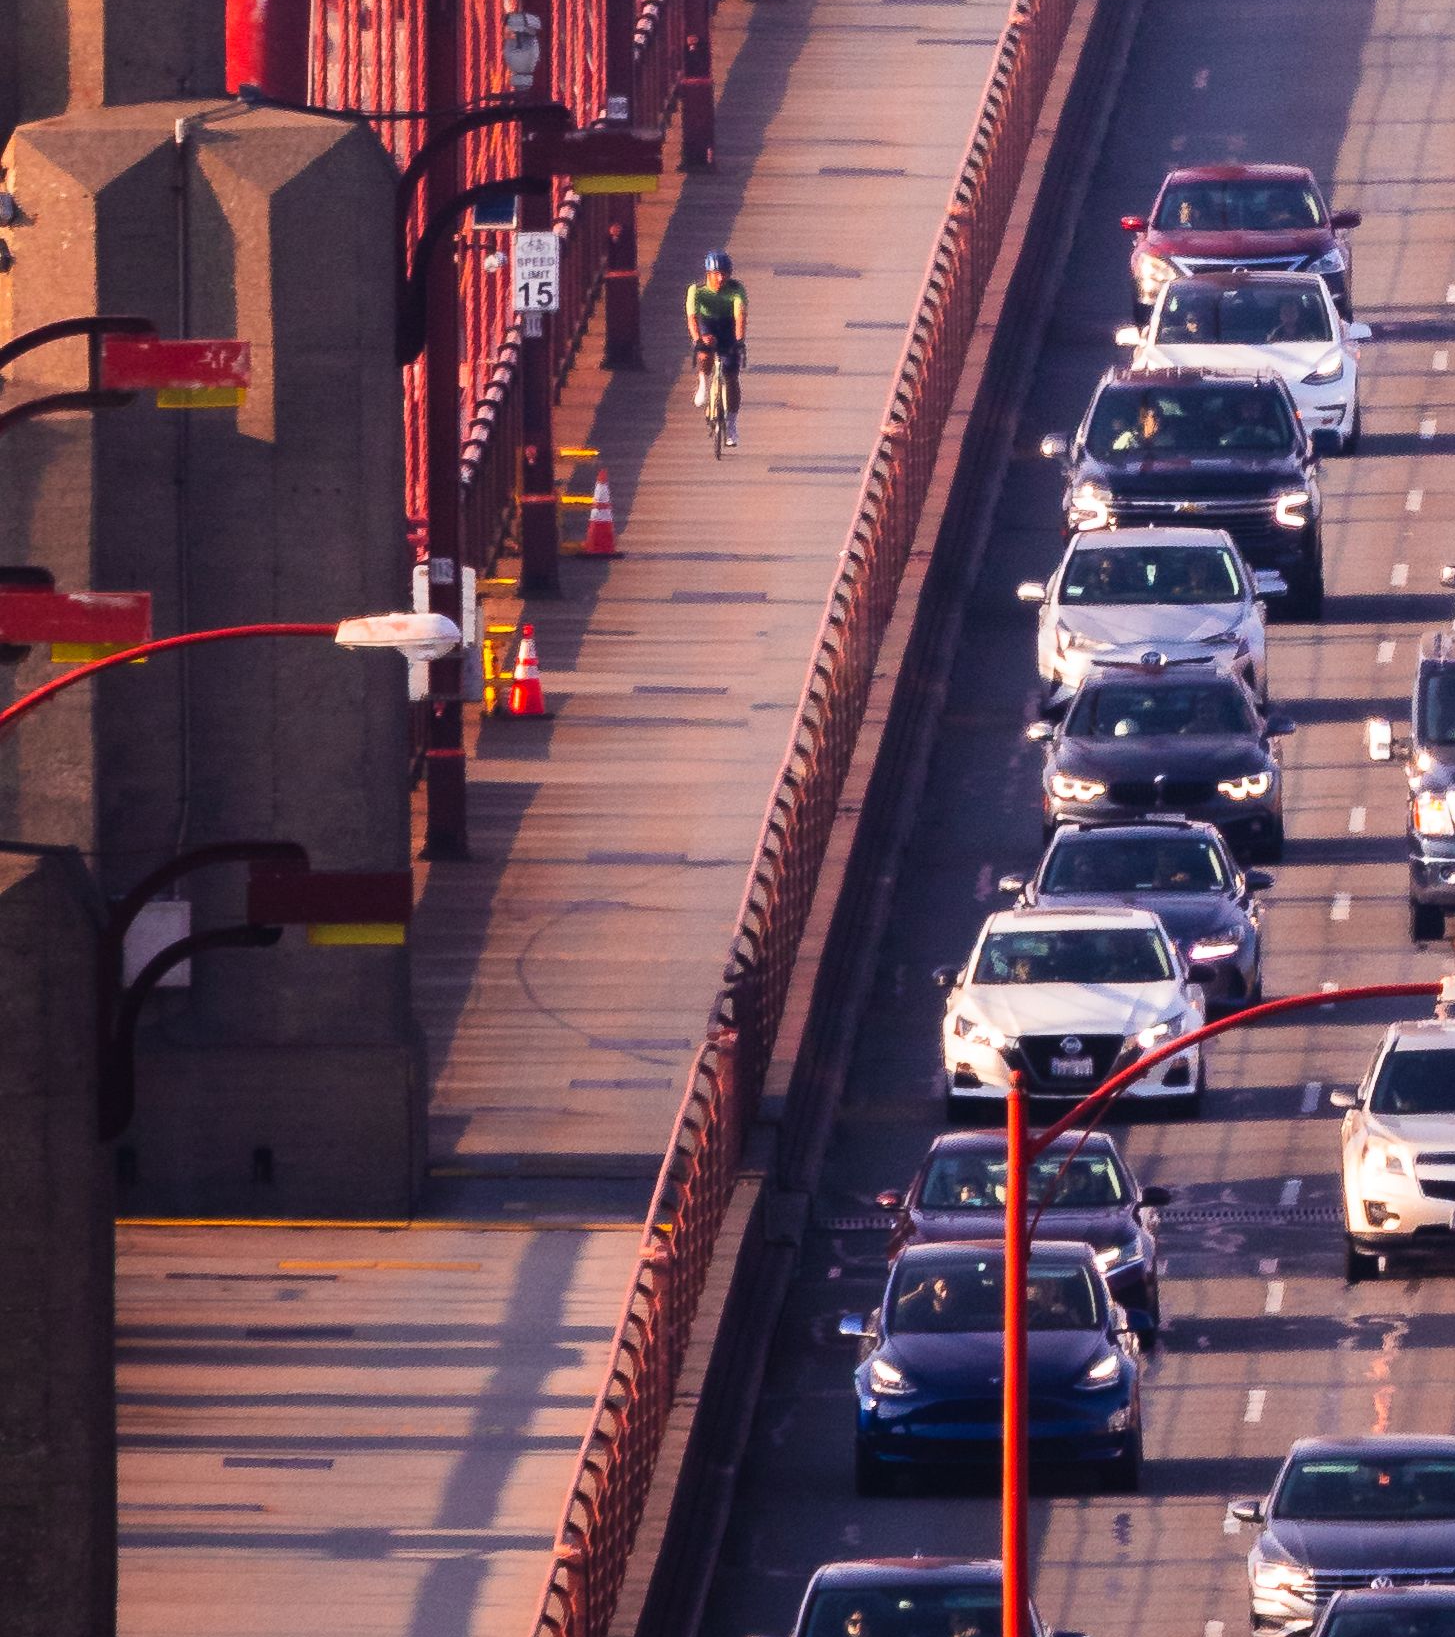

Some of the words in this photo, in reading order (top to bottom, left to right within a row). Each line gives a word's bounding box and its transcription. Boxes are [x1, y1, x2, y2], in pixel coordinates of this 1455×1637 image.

[517, 257, 555, 266] SPEED
[521, 270, 550, 279] LIMIT
[518, 281, 553, 307] 15
